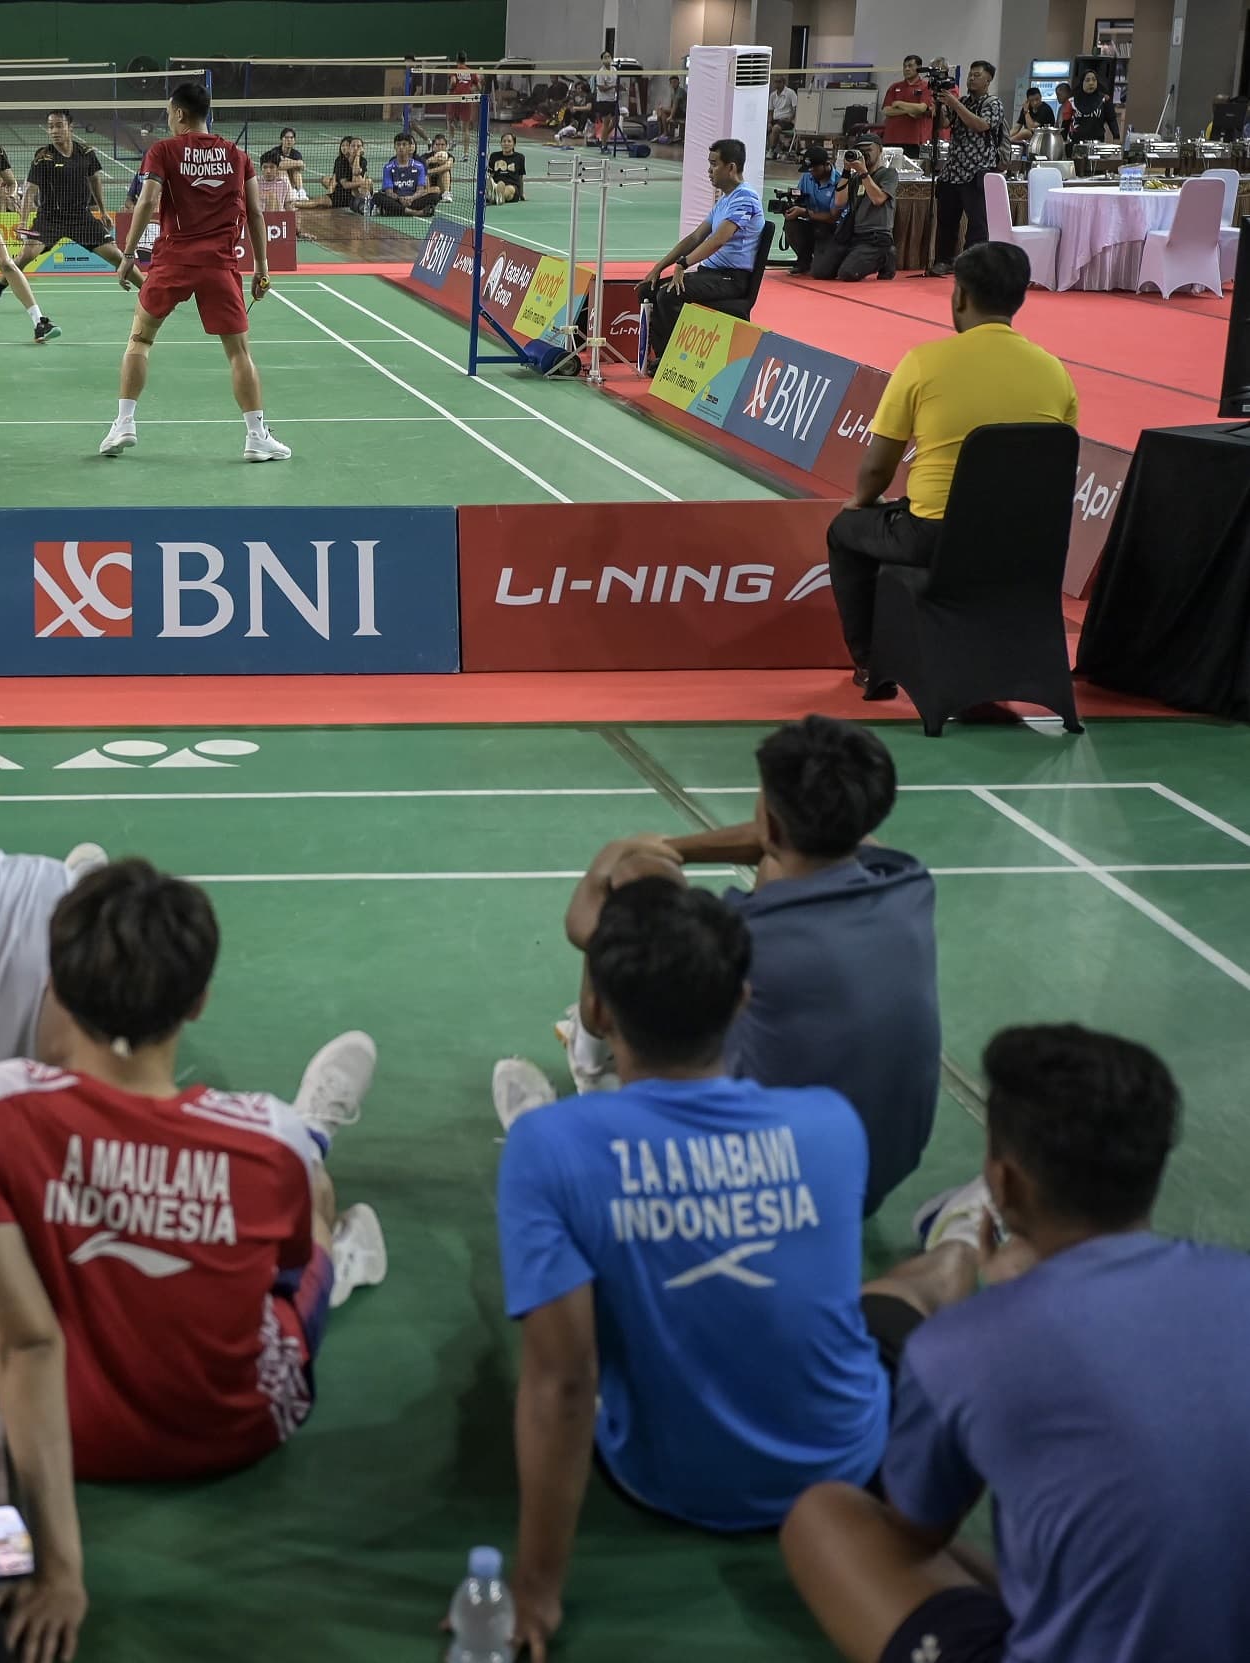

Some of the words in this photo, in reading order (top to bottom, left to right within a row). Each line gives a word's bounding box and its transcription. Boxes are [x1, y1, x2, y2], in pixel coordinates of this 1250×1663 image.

[180, 162, 234, 178] INDONESIA
[184, 147, 193, 161] R
[193, 147, 227, 164] RIVALDY
[267, 221, 287, 241] pi
[427, 235, 455, 276] BNI
[675, 321, 721, 360] wondr
[764, 363, 832, 441] BNI
[1073, 472, 1122, 522] Api
[156, 540, 383, 641] BNI
[495, 564, 776, 606] LI-NING
[62, 1134, 85, 1183] A
[90, 1138, 231, 1201] MAULANA
[686, 1125, 802, 1193] NABAWI
[44, 1179, 237, 1246] INDONESIA
[610, 1184, 820, 1244] INDONESIA
